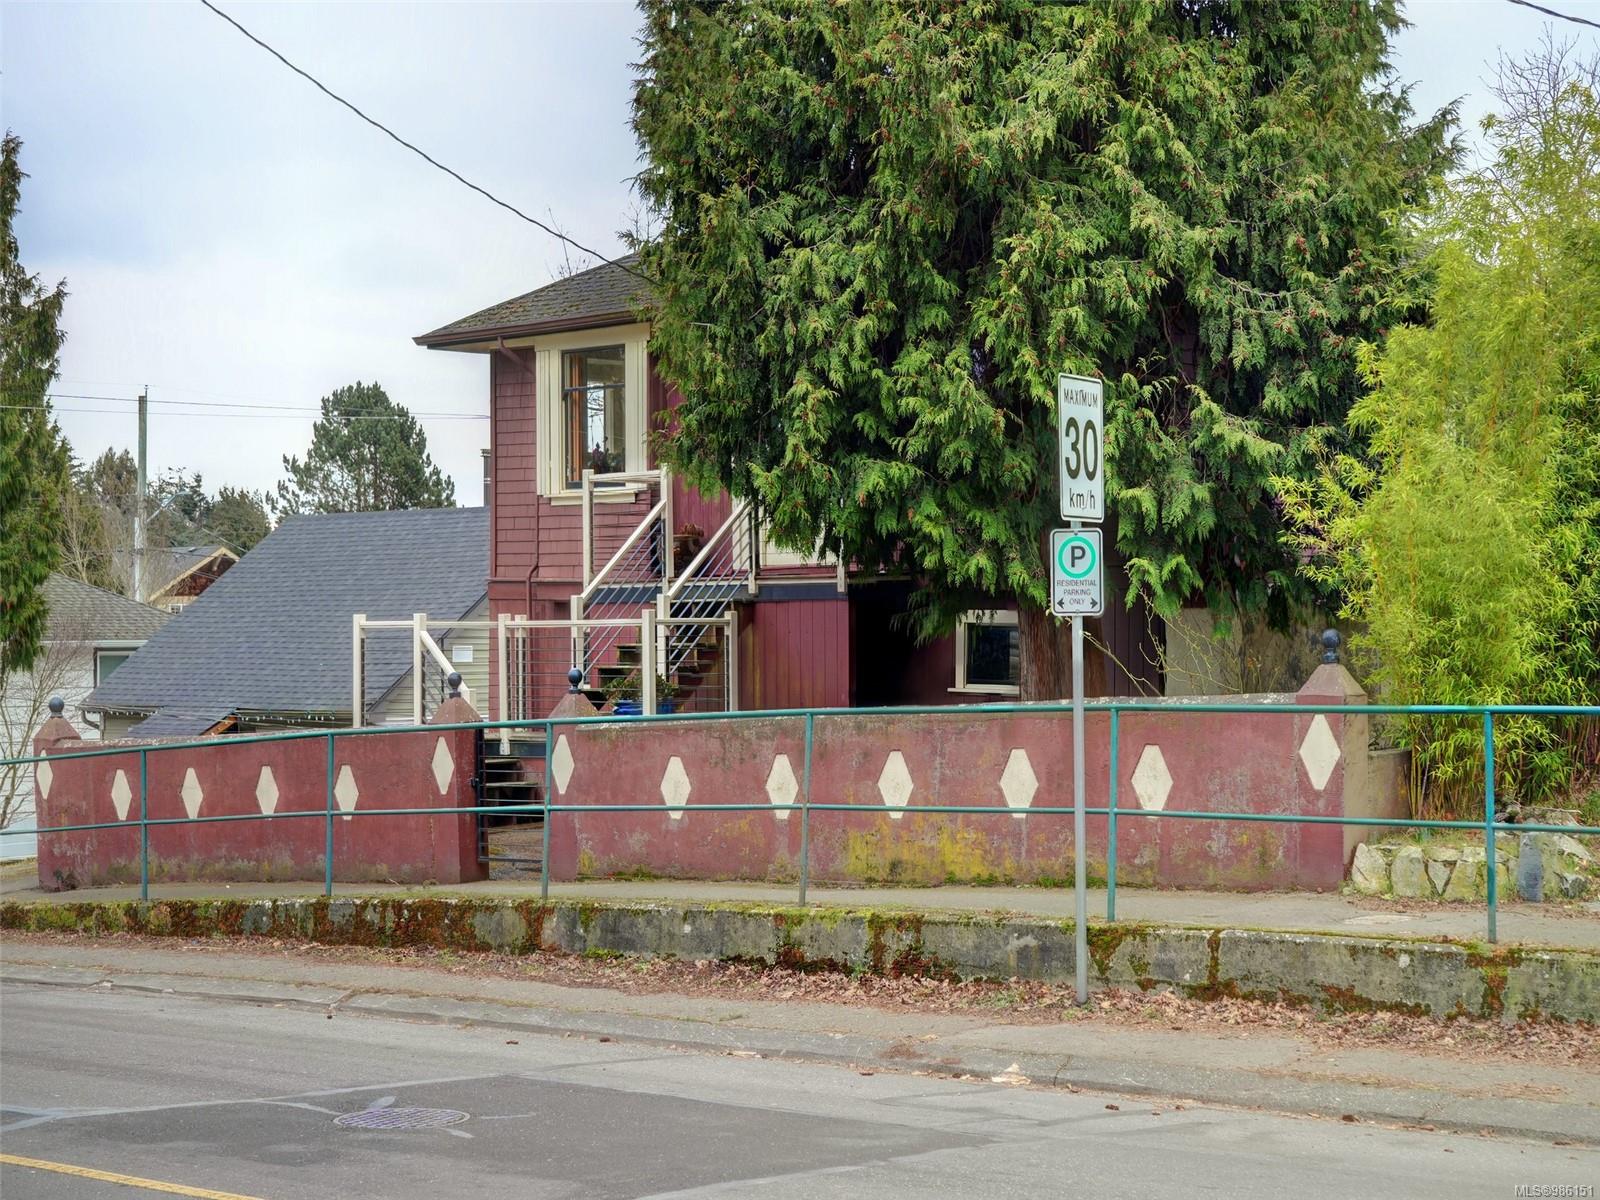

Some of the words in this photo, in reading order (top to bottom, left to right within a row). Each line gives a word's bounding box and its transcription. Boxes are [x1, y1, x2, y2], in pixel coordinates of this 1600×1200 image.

[1063, 388, 1098, 408] MAXIMUM
[1065, 416, 1098, 481] 30
[1069, 488, 1096, 510] km/h
[1070, 546, 1086, 568] P
[1056, 579, 1097, 587] RESIDENTIAL
[1063, 588, 1091, 597] PARKING
[1069, 598, 1085, 606] ONLY
